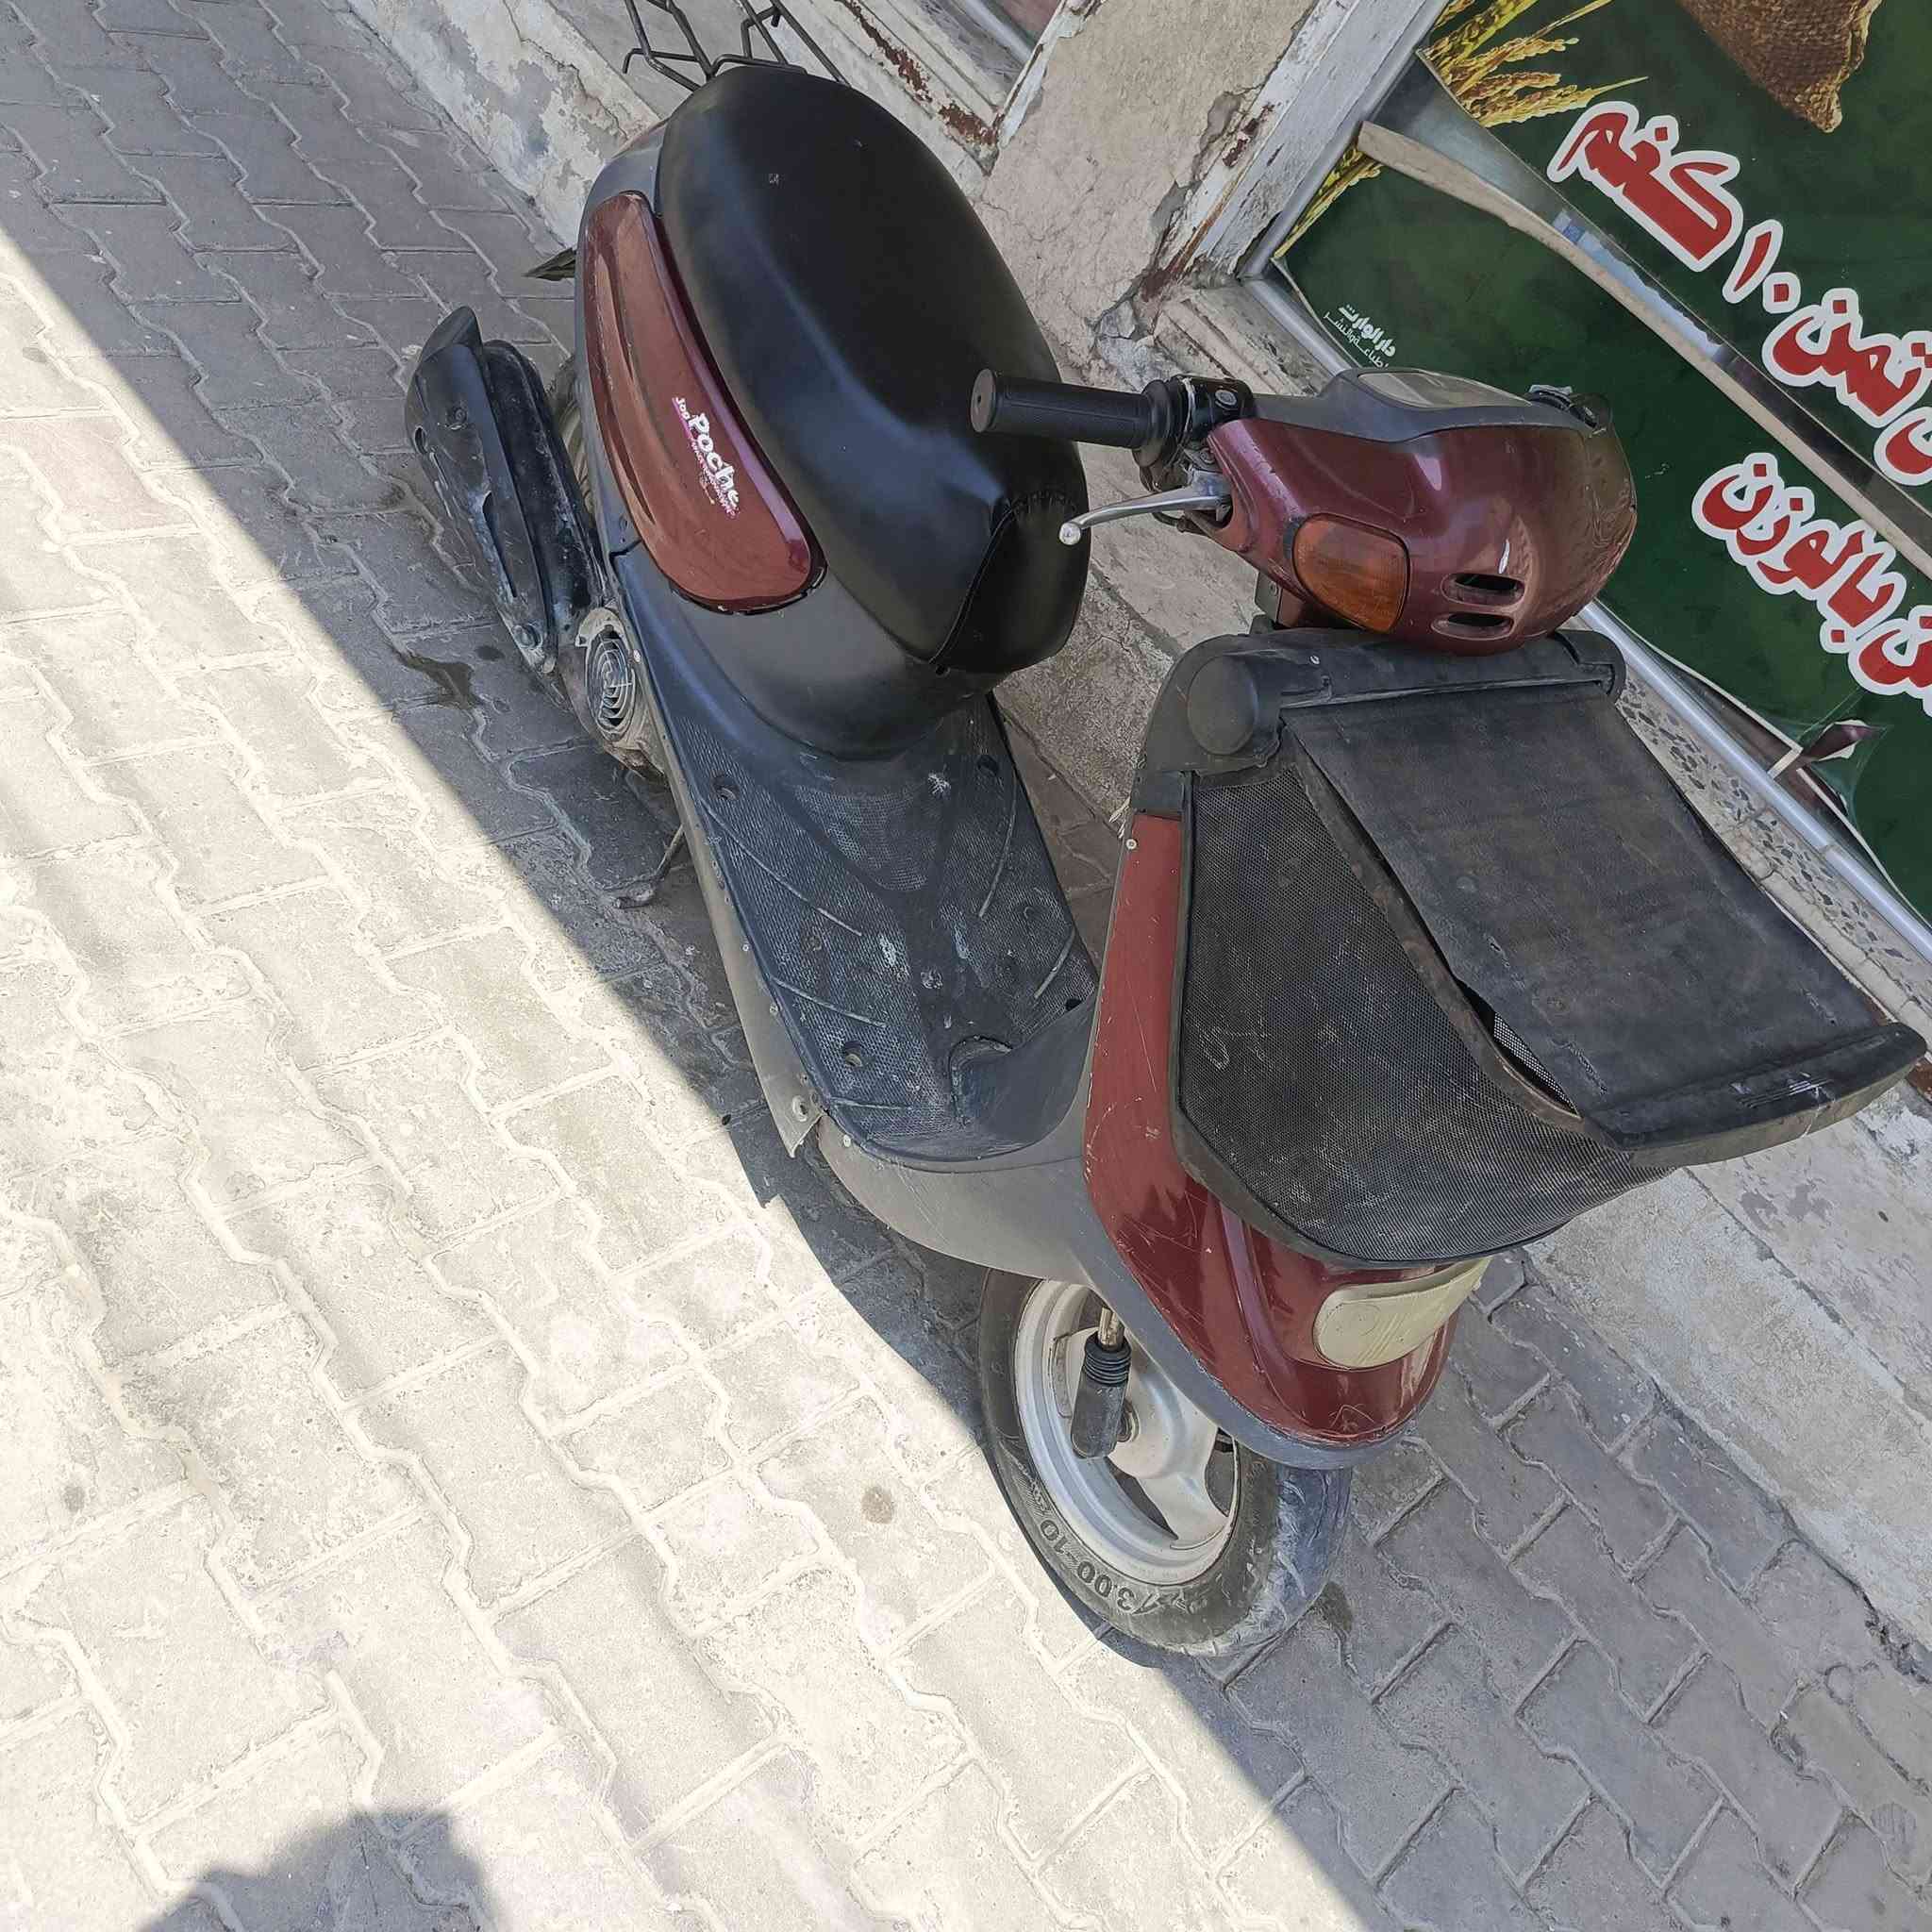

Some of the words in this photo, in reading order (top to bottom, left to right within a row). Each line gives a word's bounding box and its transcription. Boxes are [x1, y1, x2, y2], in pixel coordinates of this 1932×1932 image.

[1550, 105, 1740, 268] كغم
[1727, 225, 1795, 308] ١٠
[1374, 339, 1396, 357] دار
[689, 412, 740, 508] Poche
[1694, 457, 1903, 650] بالوزن
